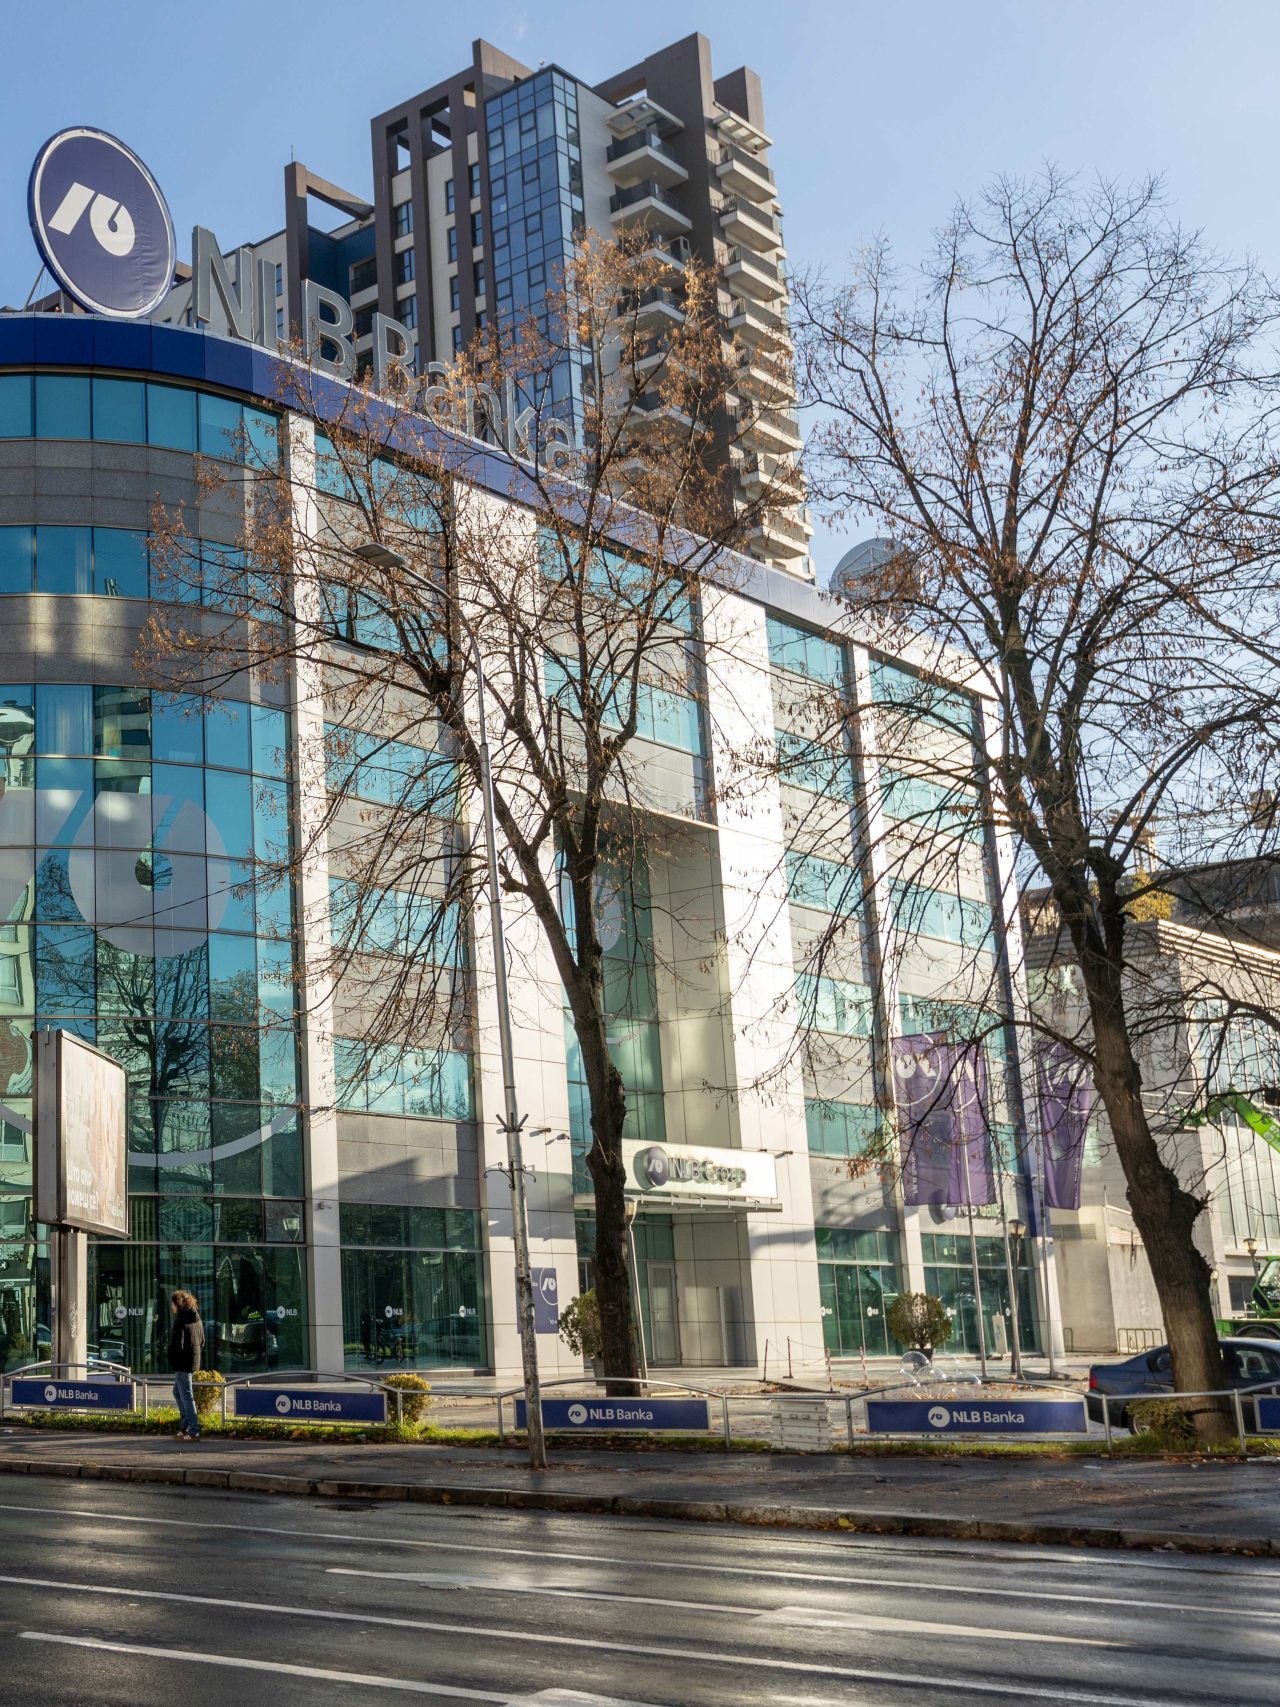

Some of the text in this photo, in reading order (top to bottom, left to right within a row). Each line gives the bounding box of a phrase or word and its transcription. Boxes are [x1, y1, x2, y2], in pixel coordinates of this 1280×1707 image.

[192, 225, 356, 380] NLB
[669, 1158, 747, 1188] NLB Group
[128, 1308, 144, 1316] NLB
[58, 1389, 99, 1401] NLB Banka
[292, 1399, 341, 1412] NLB Banka
[589, 1408, 654, 1421] NLB Banka
[952, 1410, 1025, 1423] NLB Banka
